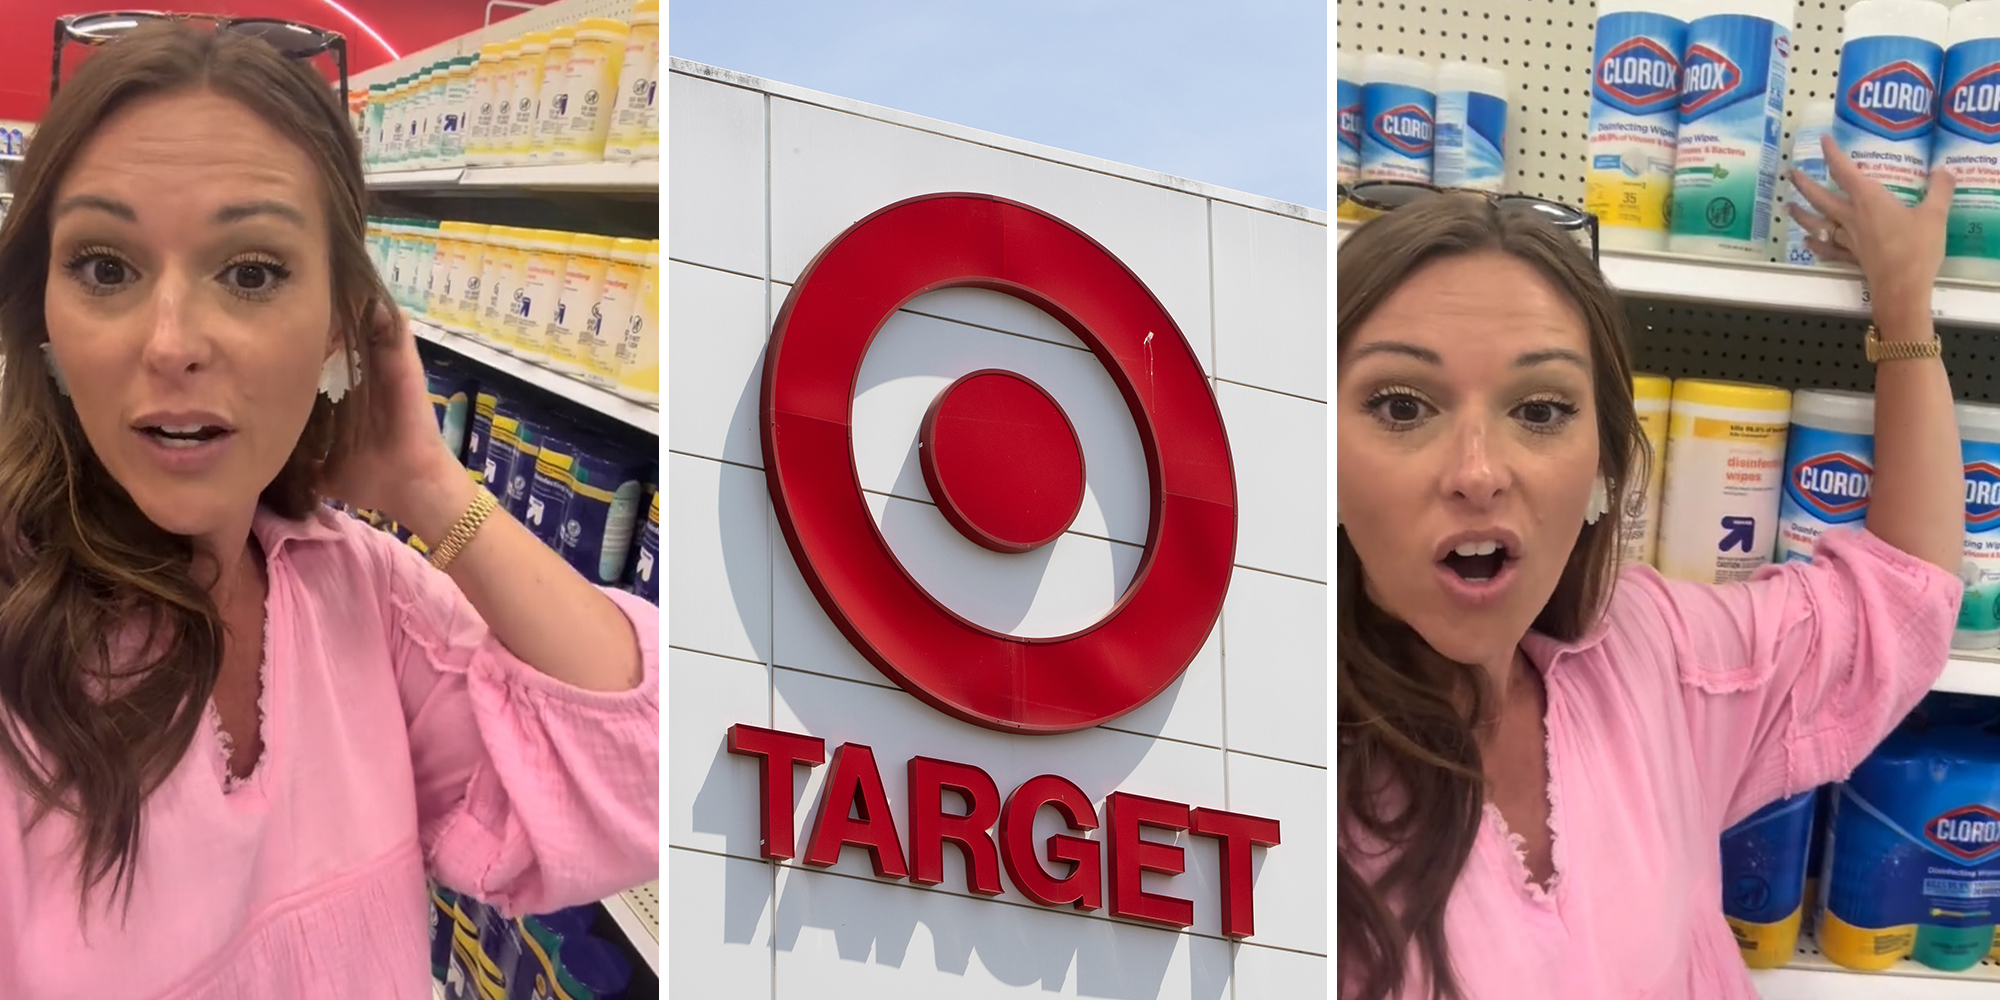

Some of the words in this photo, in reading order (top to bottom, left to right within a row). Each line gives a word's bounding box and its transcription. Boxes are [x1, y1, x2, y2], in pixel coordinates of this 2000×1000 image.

[1603, 56, 1678, 91] CLOROX
[1859, 81, 1934, 116] CLOROX
[1598, 123, 1648, 134] Disinfecting
[1851, 150, 1902, 162] Disinfecting
[1946, 156, 1998, 165] Disinfecting
[1623, 191, 1637, 204] 35
[1726, 471, 1762, 483] wipes
[727, 723, 1281, 939] TARGET
